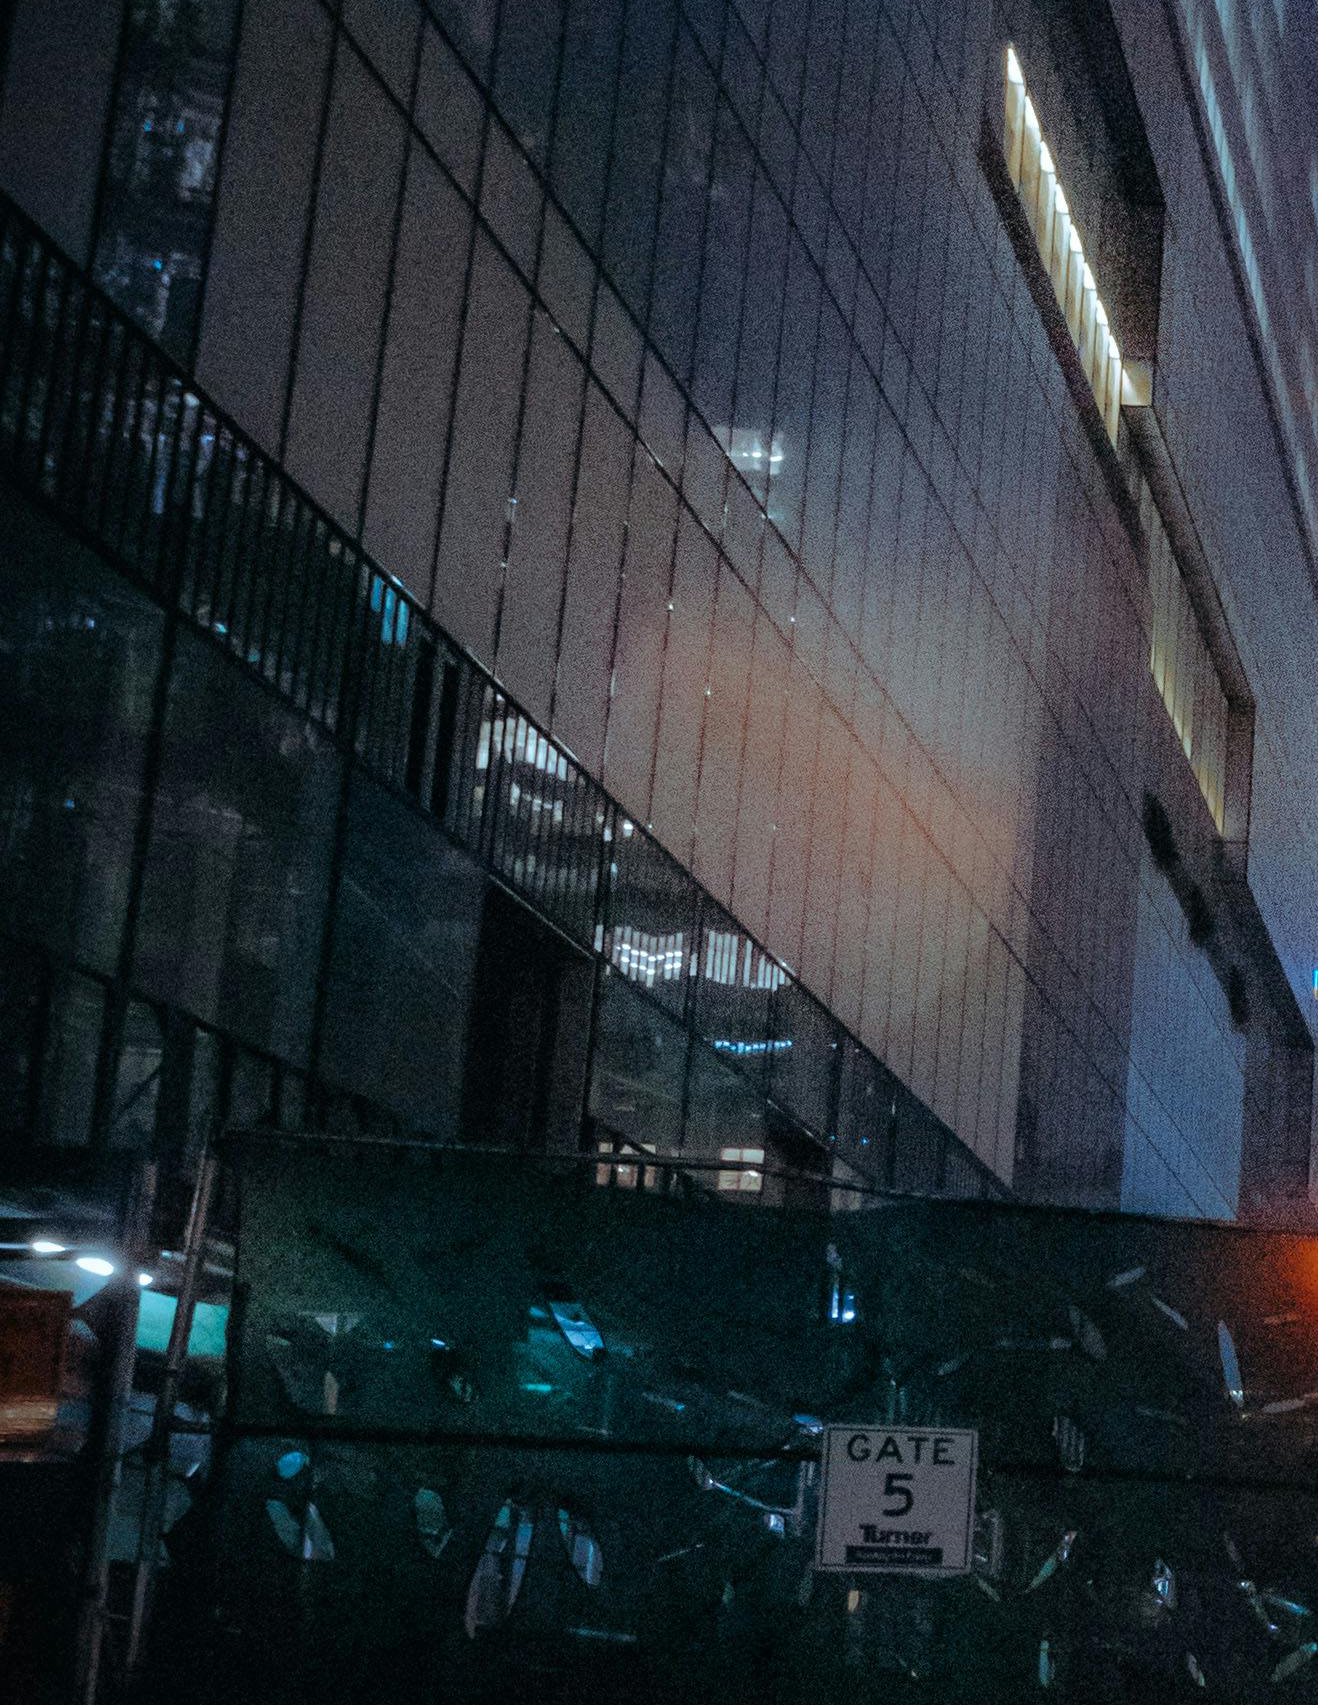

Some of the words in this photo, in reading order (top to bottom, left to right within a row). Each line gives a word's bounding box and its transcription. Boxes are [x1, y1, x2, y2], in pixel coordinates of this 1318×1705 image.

[847, 1434, 955, 1465] GATE
[883, 1473, 914, 1516] 5
[858, 1524, 932, 1545] Turner
